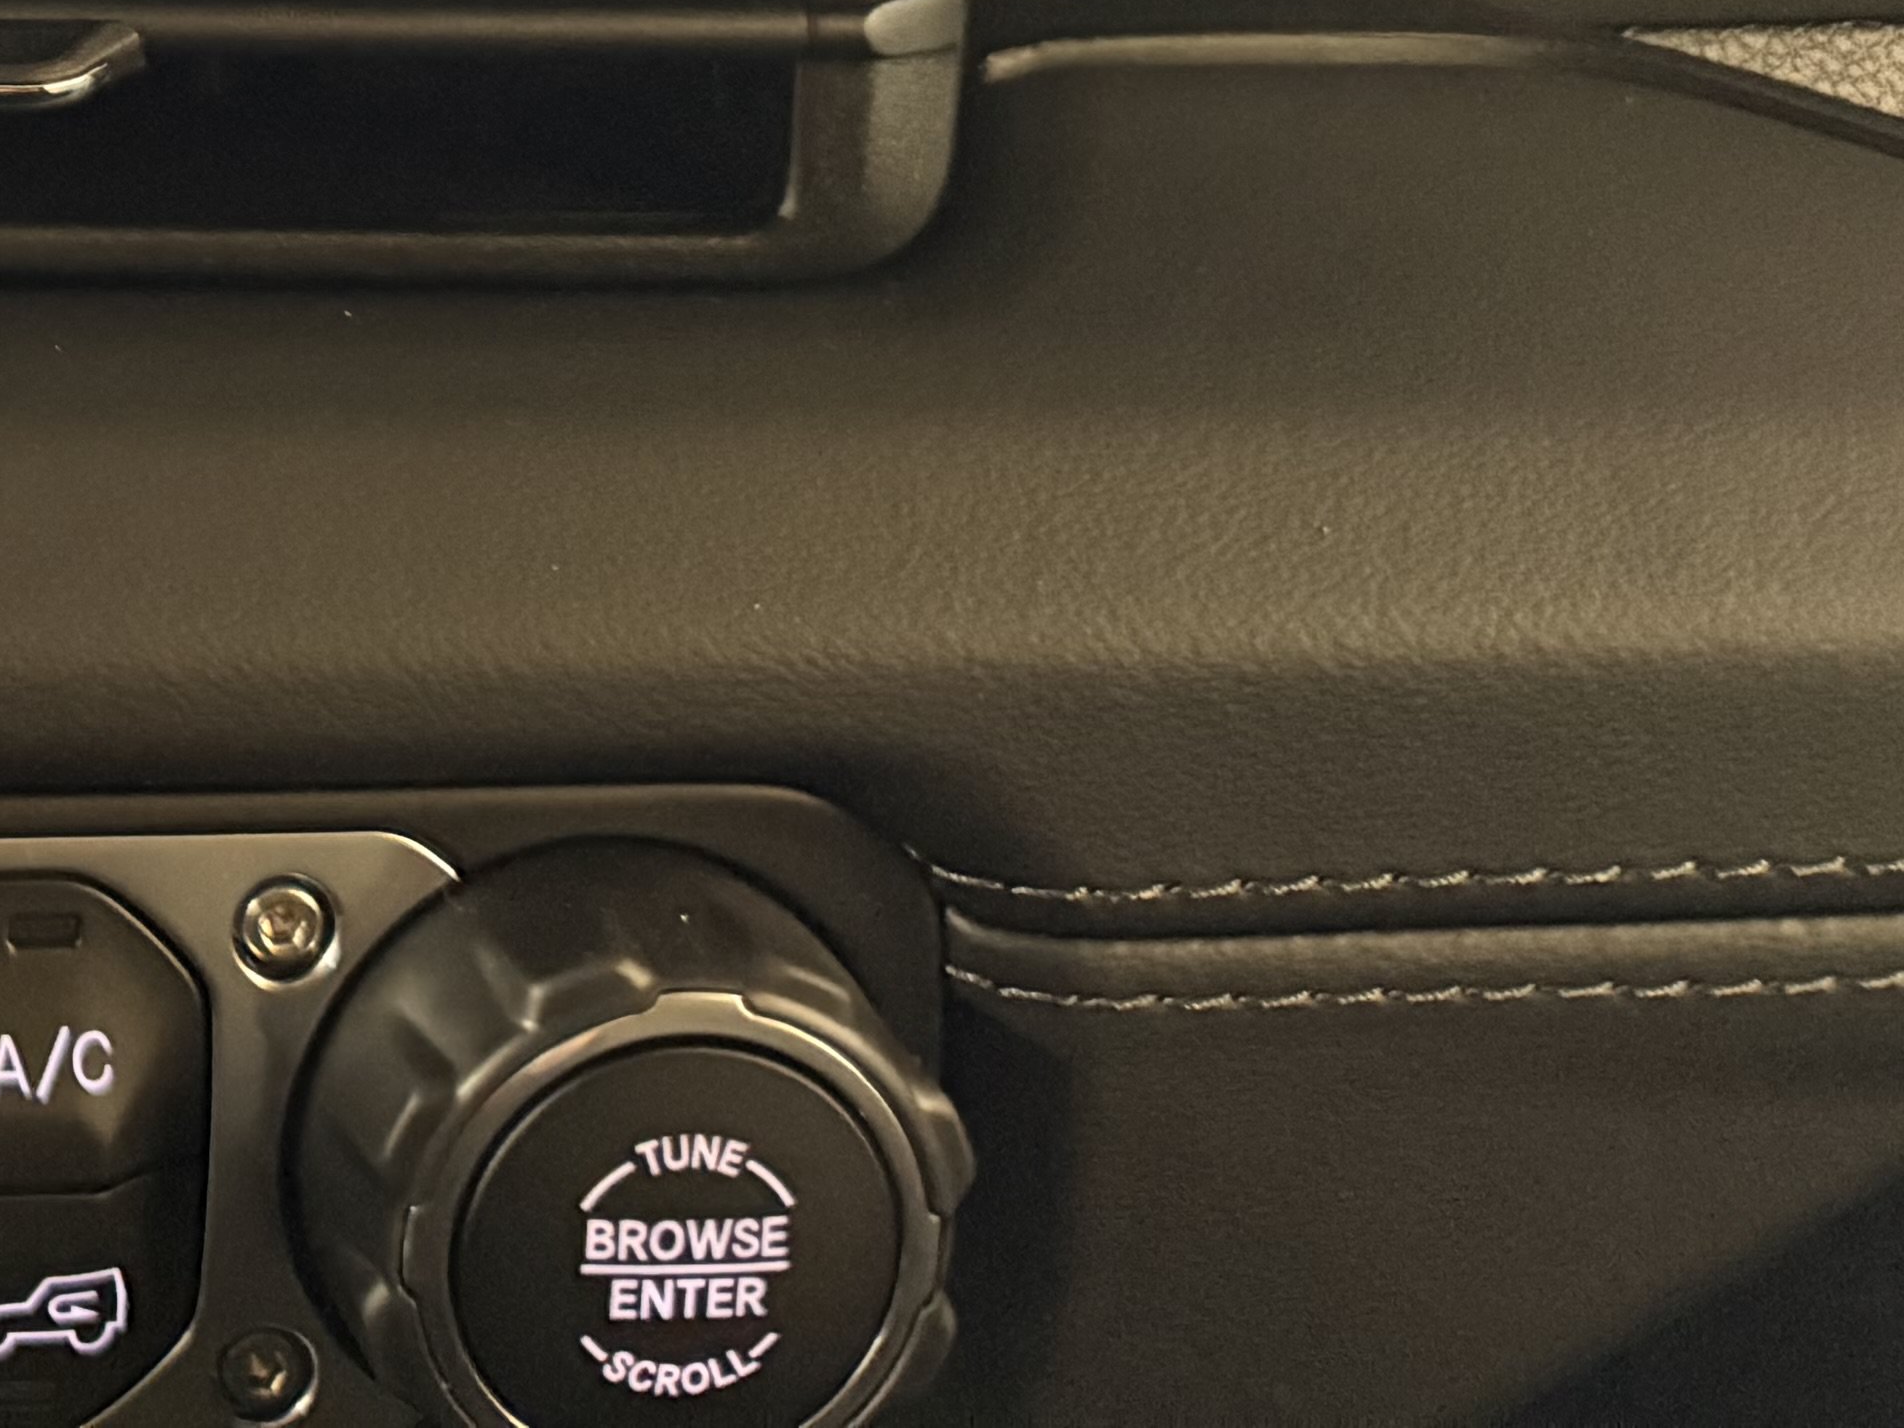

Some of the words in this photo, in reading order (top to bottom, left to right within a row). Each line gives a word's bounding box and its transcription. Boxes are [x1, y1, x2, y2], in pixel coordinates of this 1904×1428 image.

[634, 1132, 750, 1178] TUNE
[583, 1214, 790, 1261] BROWSE
[608, 1276, 768, 1321] ENTER
[601, 1348, 763, 1398] SCROLL
